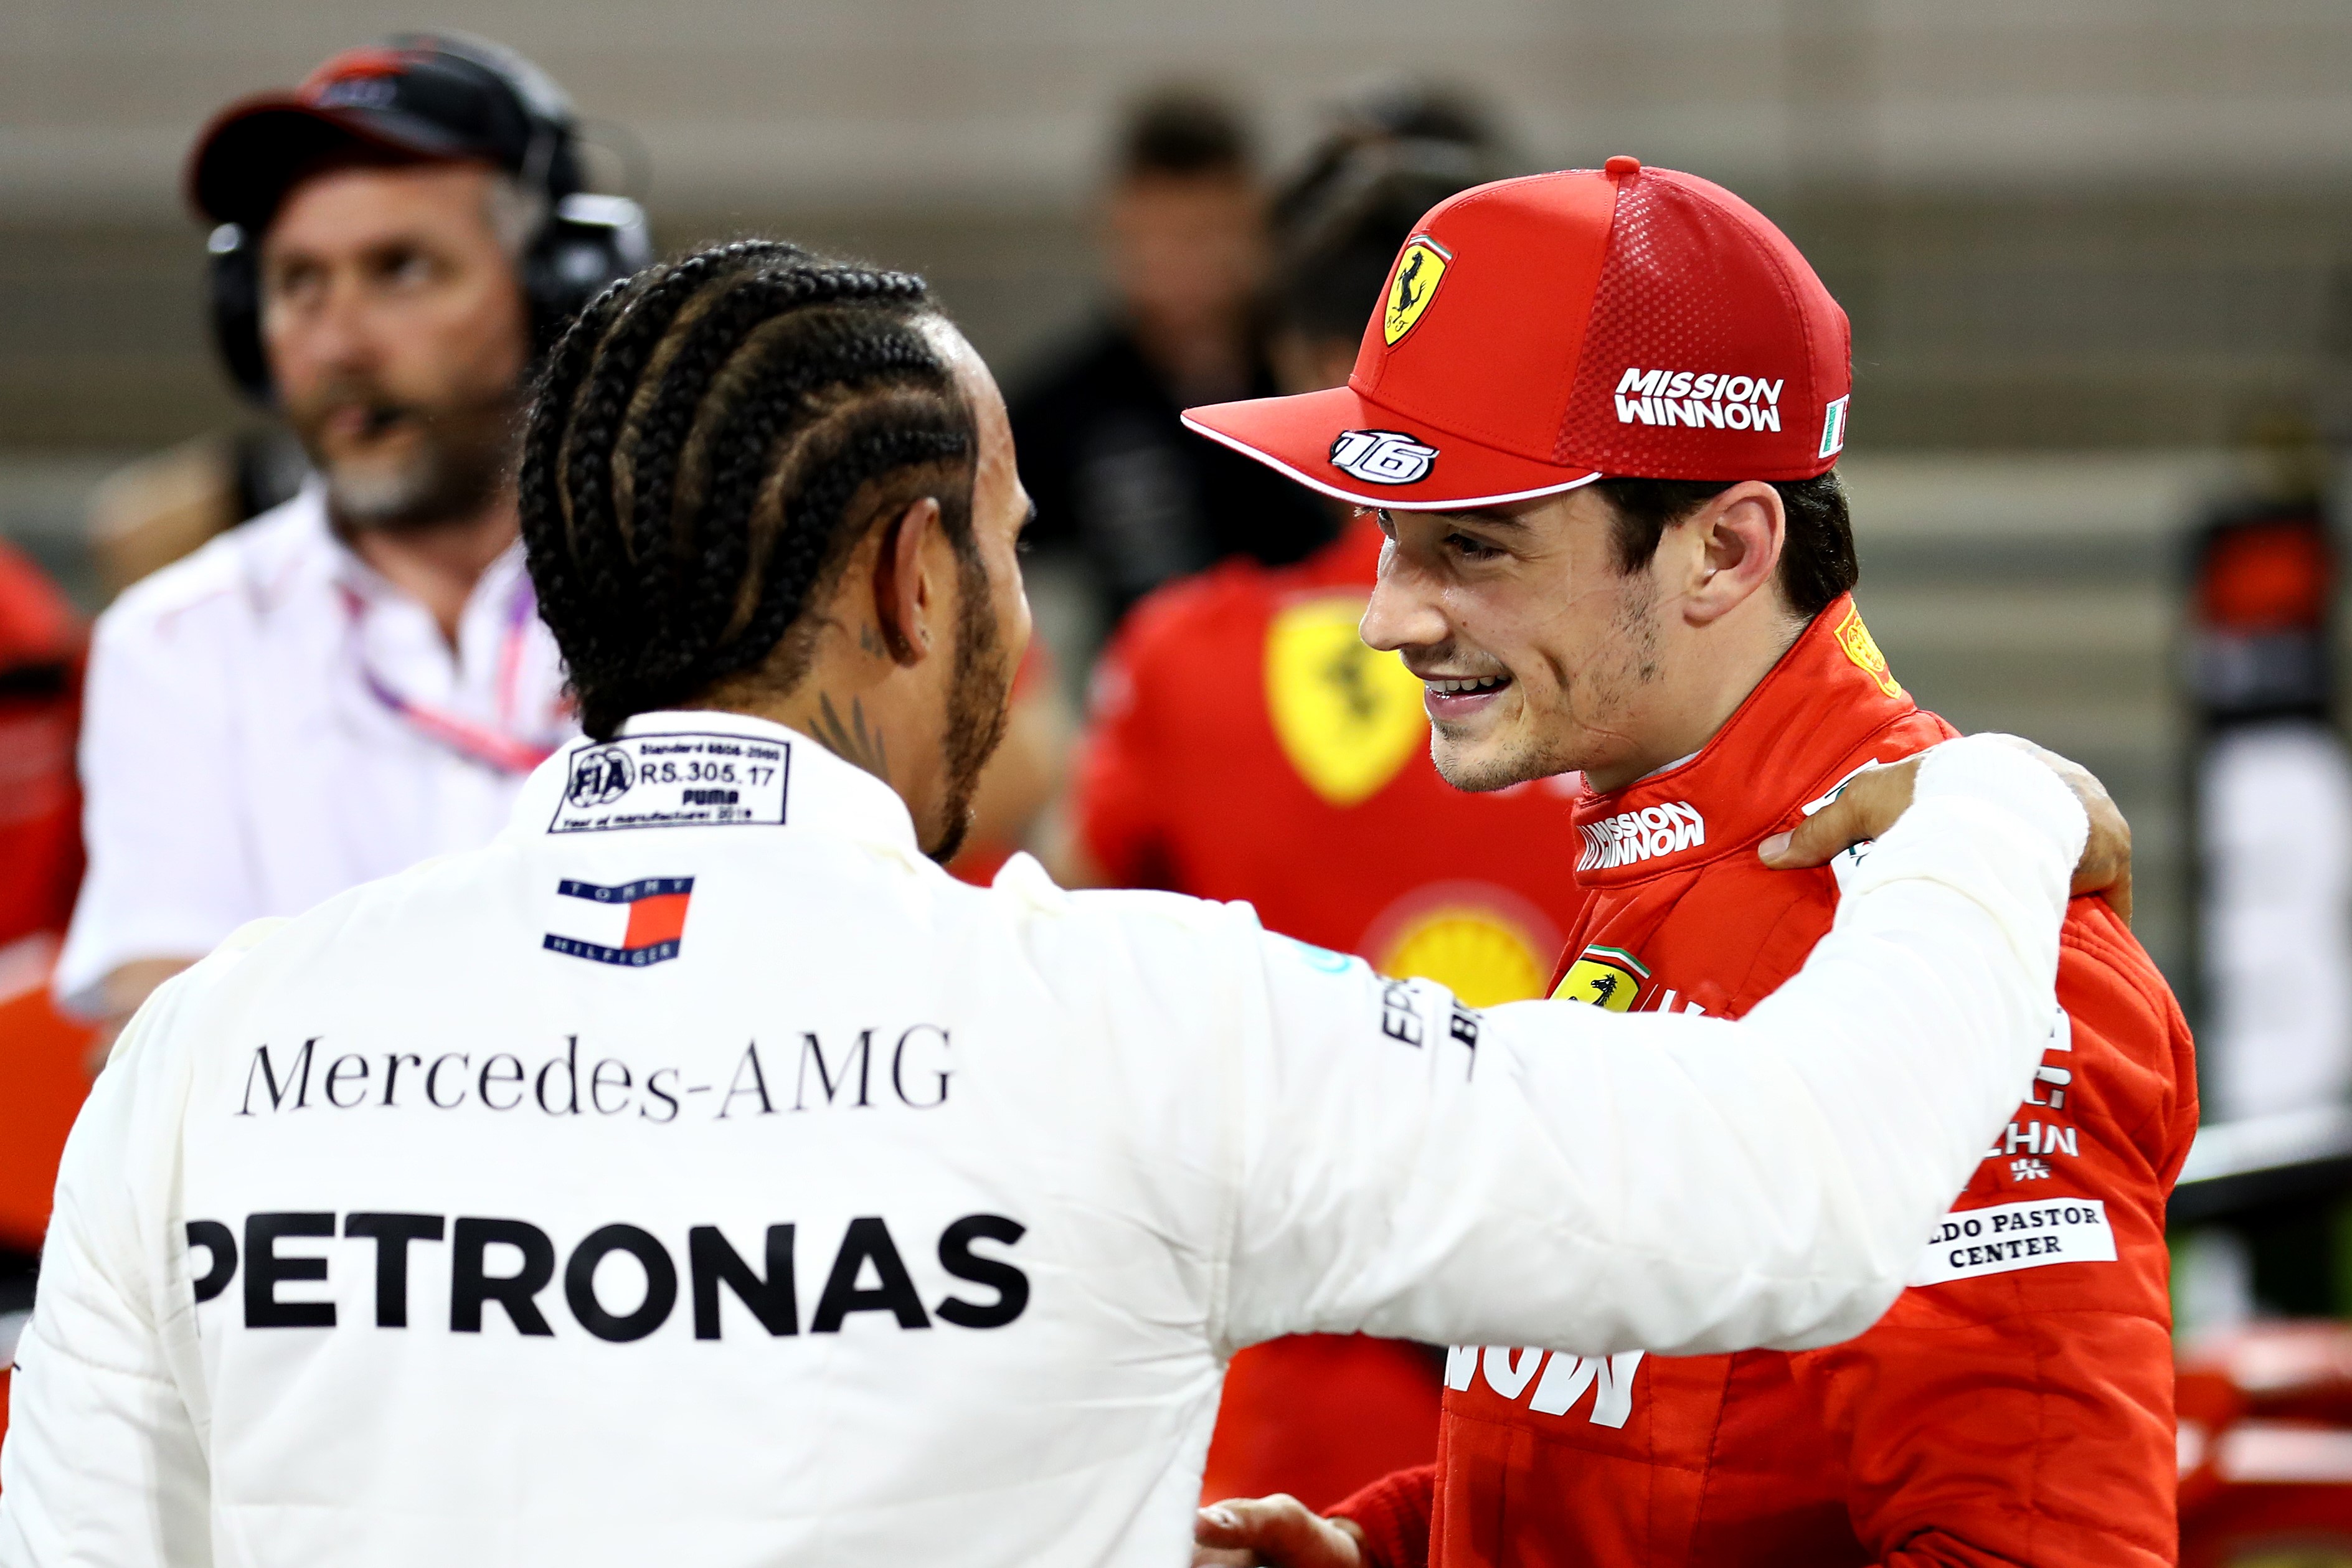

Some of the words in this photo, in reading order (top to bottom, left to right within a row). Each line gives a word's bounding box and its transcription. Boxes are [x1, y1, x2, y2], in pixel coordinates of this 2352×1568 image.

[1615, 368, 1784, 405] MISSION
[1614, 394, 1781, 432] WINNOW
[1331, 431, 1440, 479] 16
[570, 760, 628, 800] FIA
[1575, 801, 1703, 842] MISSION
[571, 879, 684, 900] TOMMY
[553, 938, 671, 966] HILFIGER
[235, 1024, 955, 1123] Mercedes-AMG
[1991, 1207, 2100, 1234] PASTOR
[1948, 1235, 2062, 1268] CENTER
[186, 1212, 1029, 1343] PETRONAS
